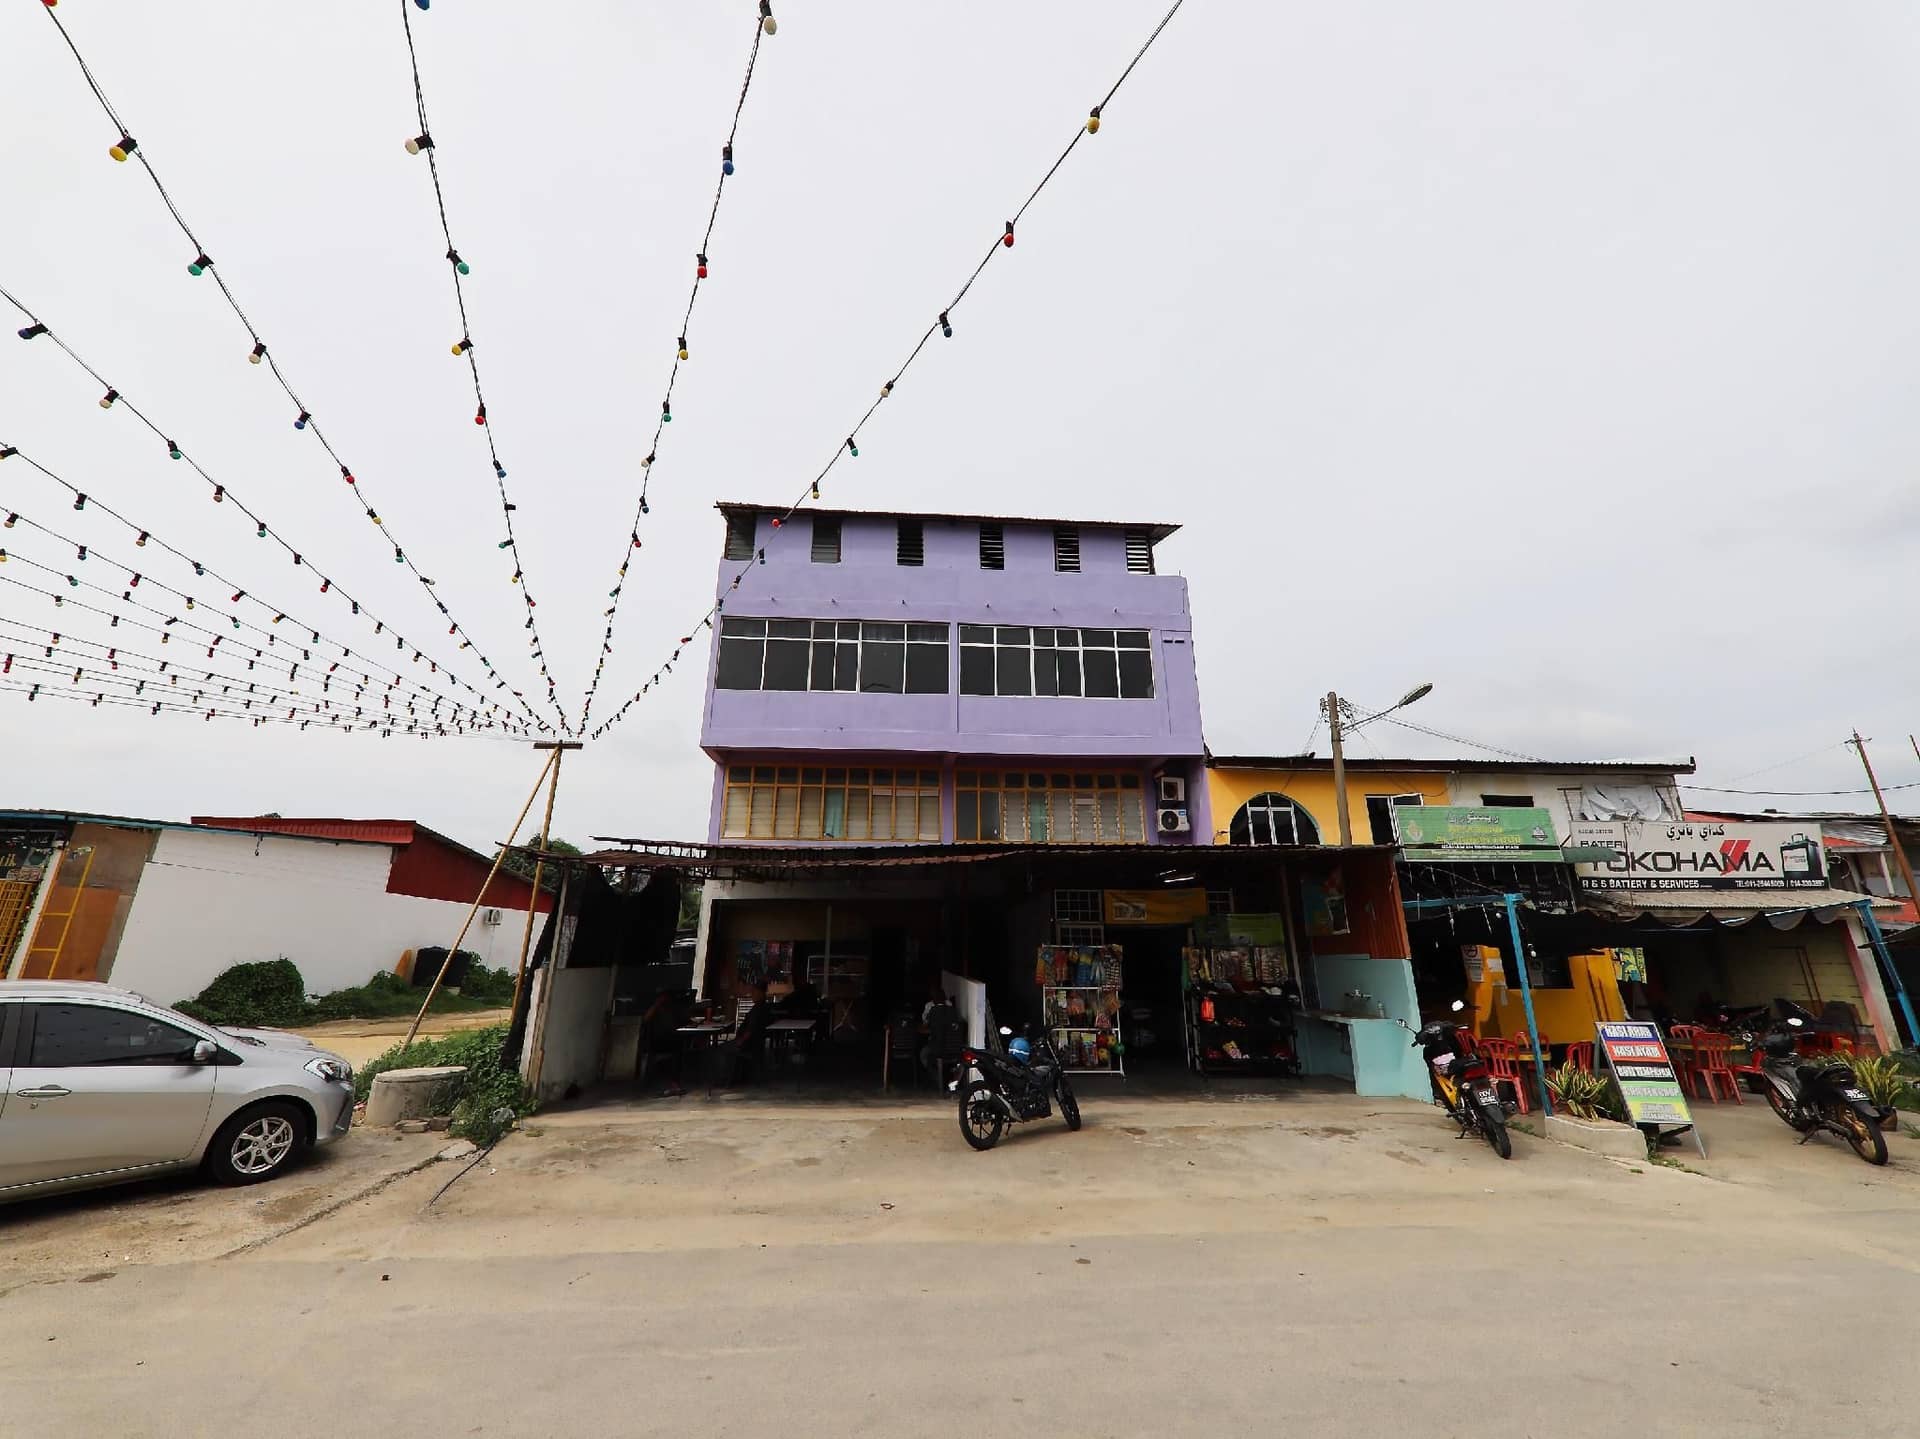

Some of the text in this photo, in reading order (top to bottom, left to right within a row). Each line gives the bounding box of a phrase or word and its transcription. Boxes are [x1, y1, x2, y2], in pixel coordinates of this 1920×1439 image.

[1610, 880, 1648, 888] BATTERY
[1650, 880, 1658, 888] &
[1660, 880, 1700, 888] SERVICES
